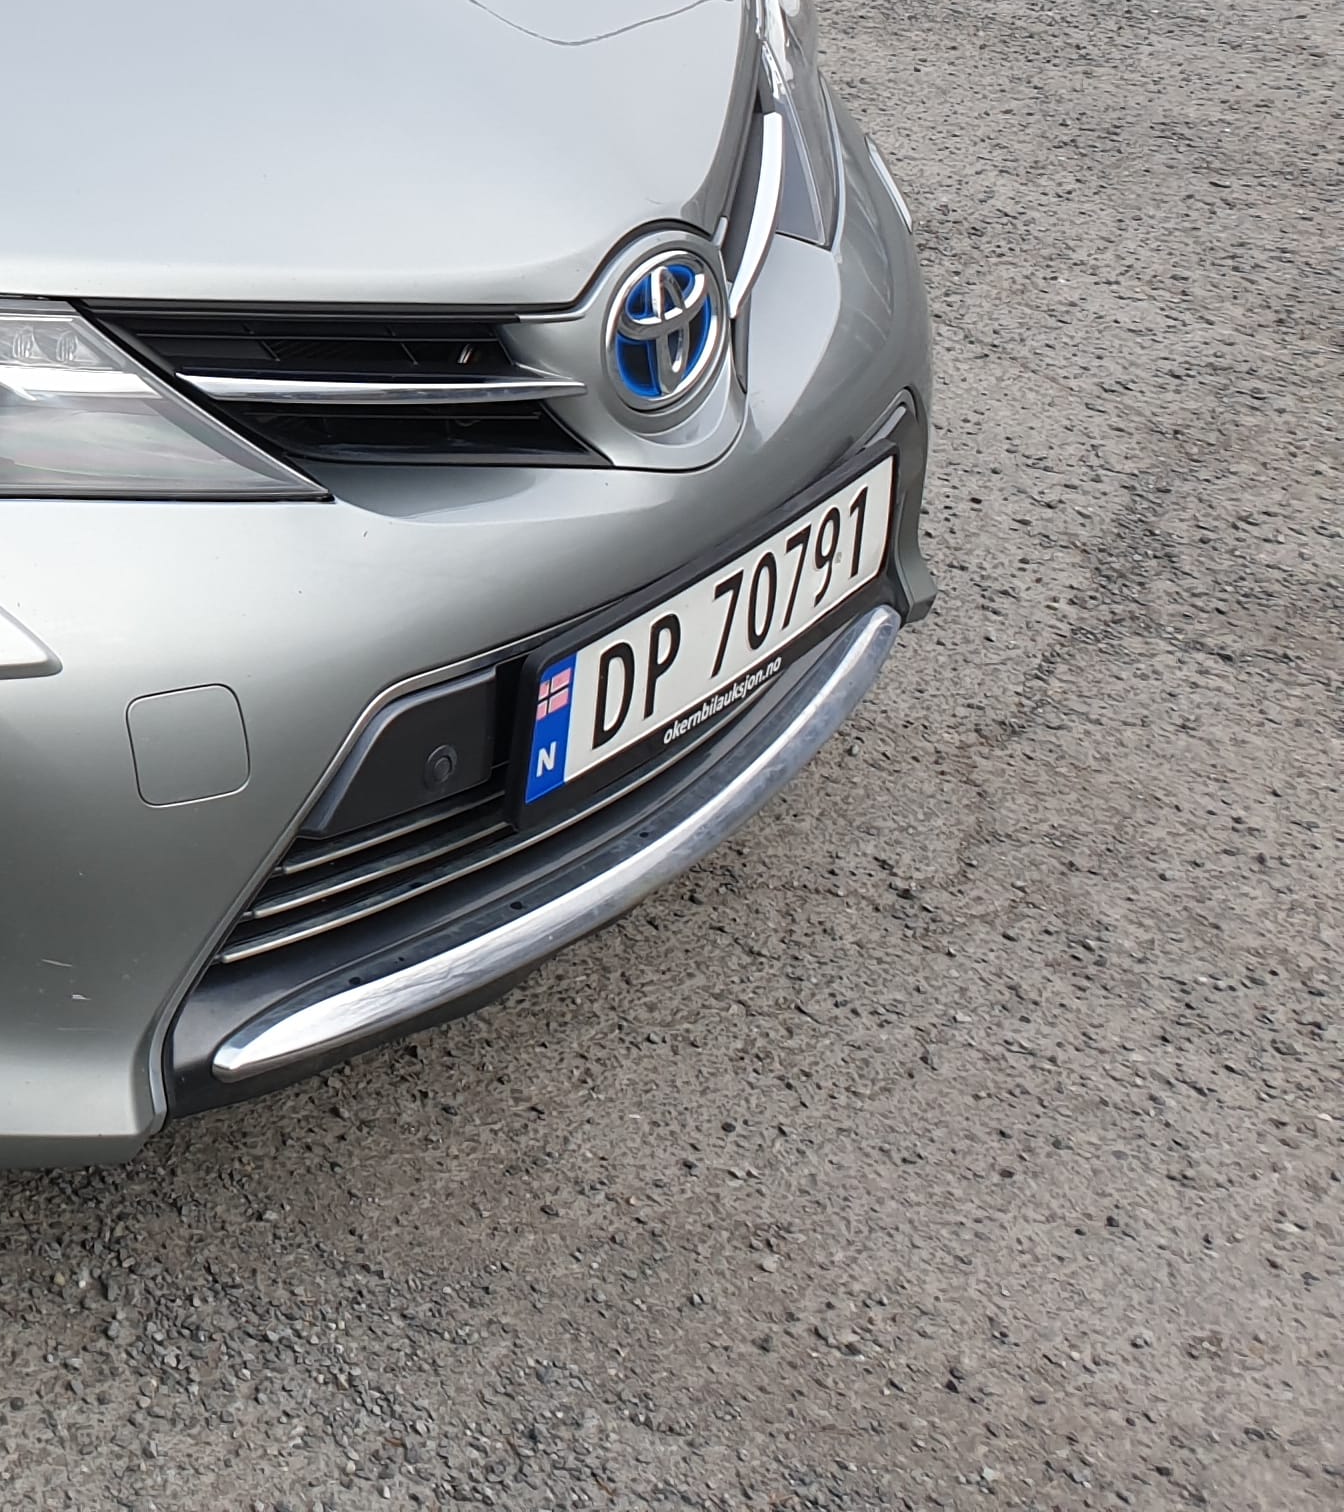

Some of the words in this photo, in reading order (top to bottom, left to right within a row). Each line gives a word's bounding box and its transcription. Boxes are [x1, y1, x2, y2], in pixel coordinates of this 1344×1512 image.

[592, 612, 681, 750] DP
[709, 486, 869, 680] 70791
[664, 657, 782, 744] okernbilauksjon.no
[536, 742, 557, 778] N
